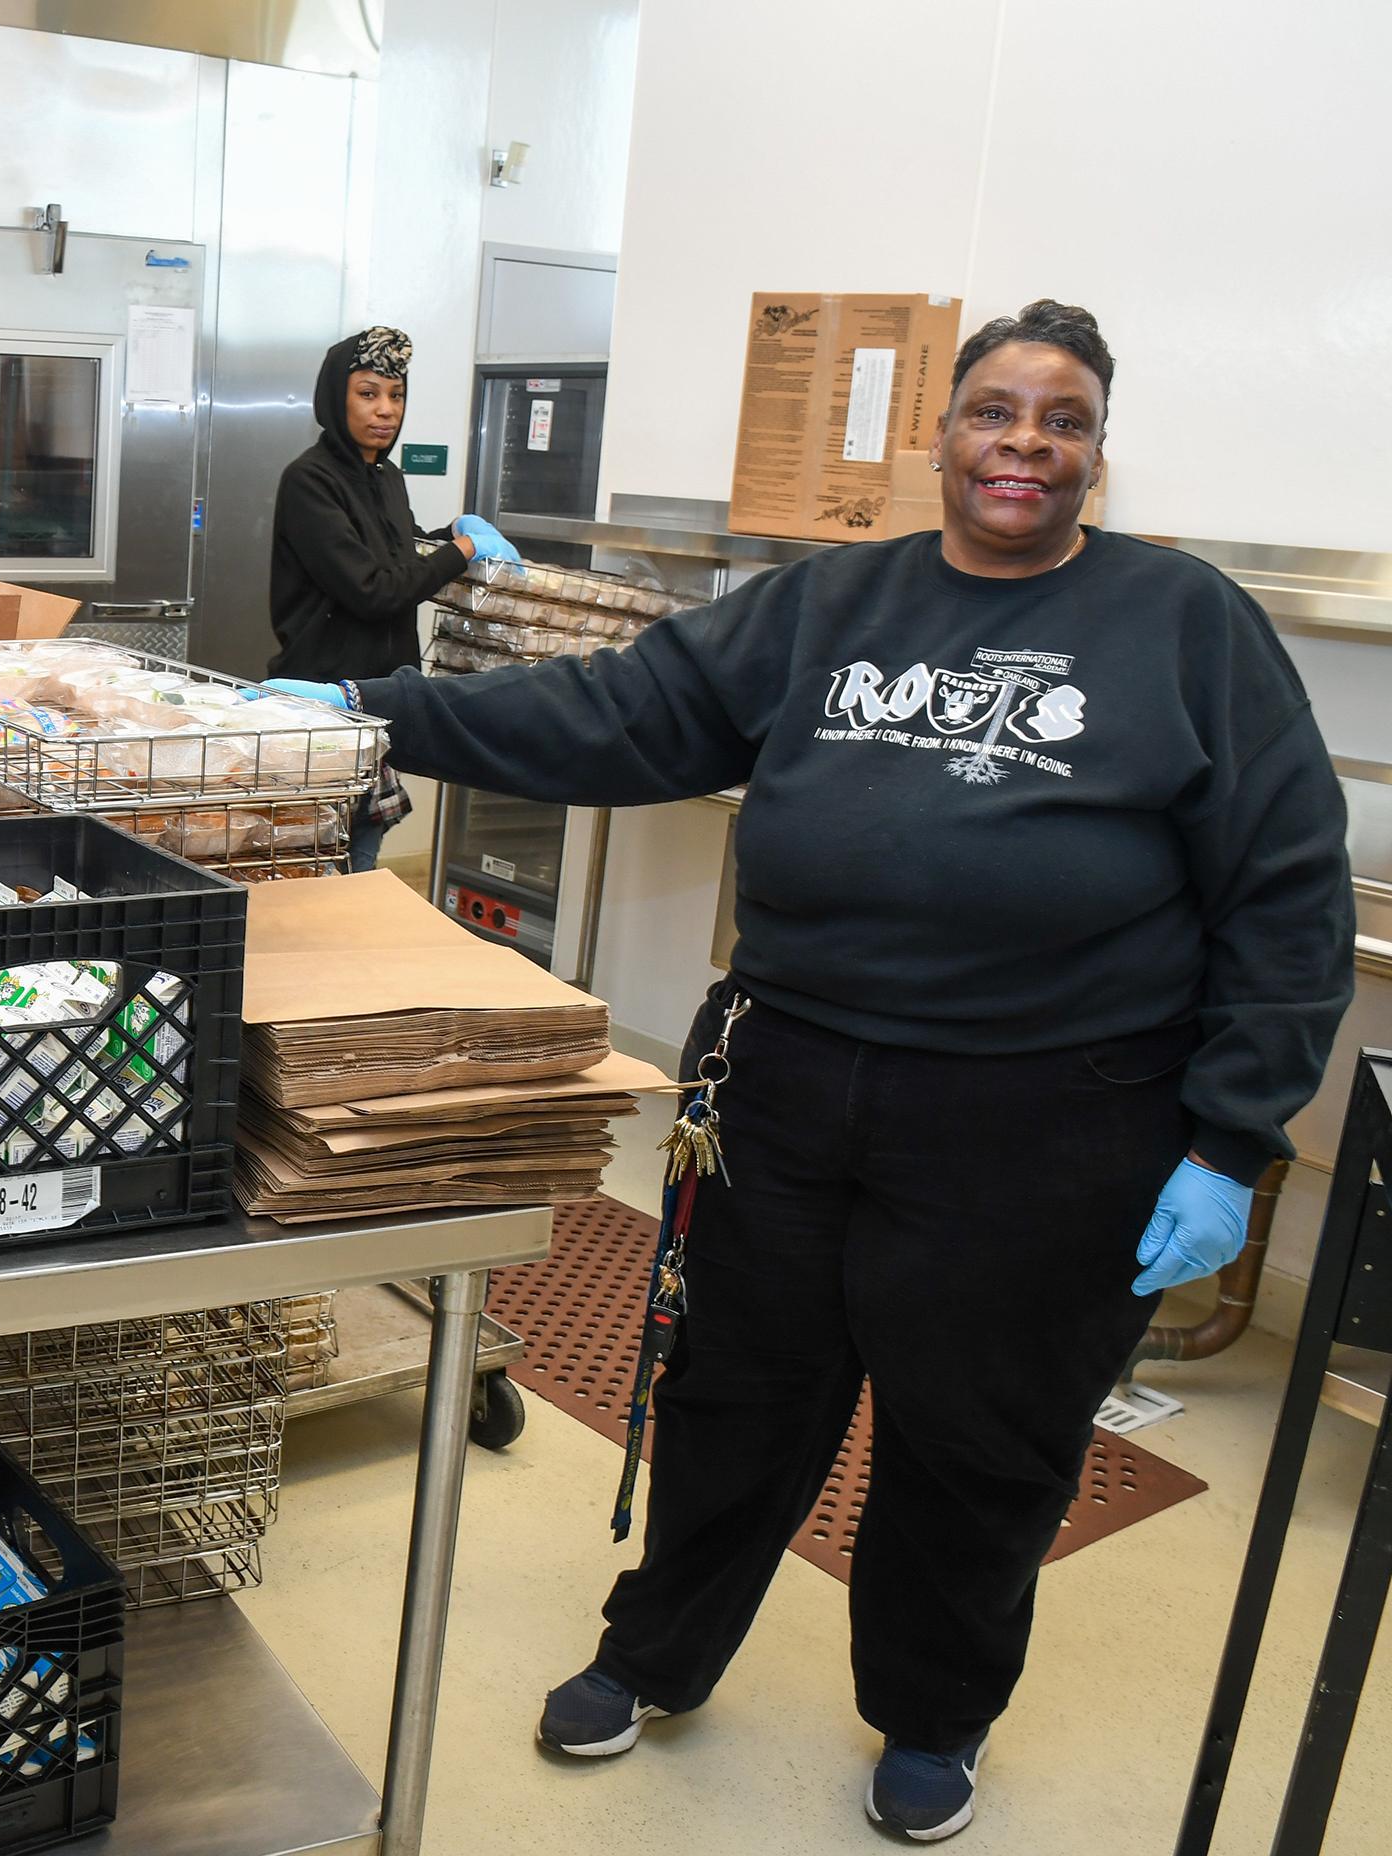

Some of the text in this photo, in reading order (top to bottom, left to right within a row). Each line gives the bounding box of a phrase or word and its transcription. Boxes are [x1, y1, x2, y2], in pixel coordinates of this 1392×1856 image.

[911, 393, 923, 431] WITH
[917, 344, 929, 388] CARE
[975, 651, 1068, 667] ROOTS INTERNATIONAL
[1033, 663, 1067, 672] ACADEMY
[940, 674, 998, 692] RAIDERS
[1003, 670, 1040, 689] OAKLAND
[814, 727, 820, 739] I
[820, 728, 846, 741] KNOW
[845, 729, 876, 741] WHERE
[875, 729, 881, 740] I
[881, 729, 911, 747] COME
[942, 738, 949, 749] I
[949, 739, 980, 753] KNOW
[980, 742, 1018, 761] WHERE
[1019, 749, 1036, 765] I'M
[623, 1424, 641, 1495] WARRIORS
